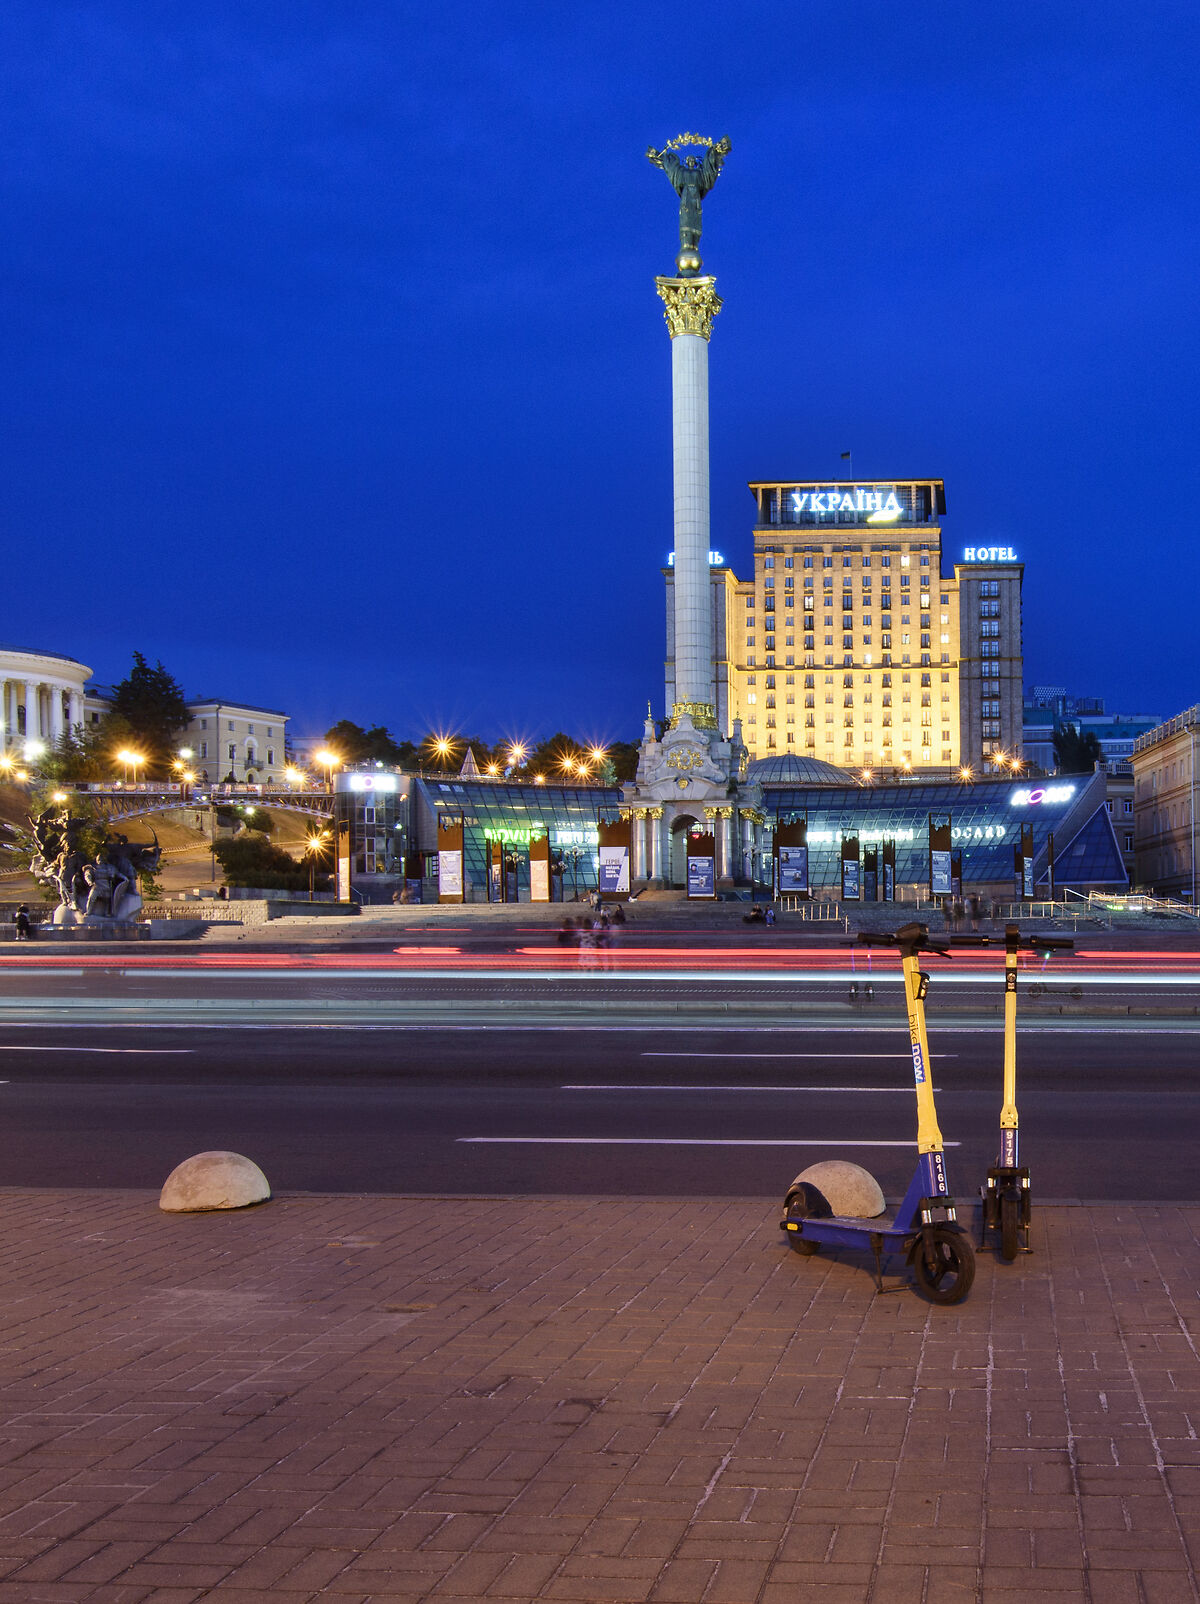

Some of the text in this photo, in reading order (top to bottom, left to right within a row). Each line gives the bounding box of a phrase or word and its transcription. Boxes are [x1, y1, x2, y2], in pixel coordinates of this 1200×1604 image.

[791, 489, 904, 512] УКРАЇНА
[964, 547, 1017, 561] HOTEL
[484, 828, 544, 844] NOVUS
[1006, 1131, 1014, 1165] 9175
[934, 1154, 946, 1192] 8166
